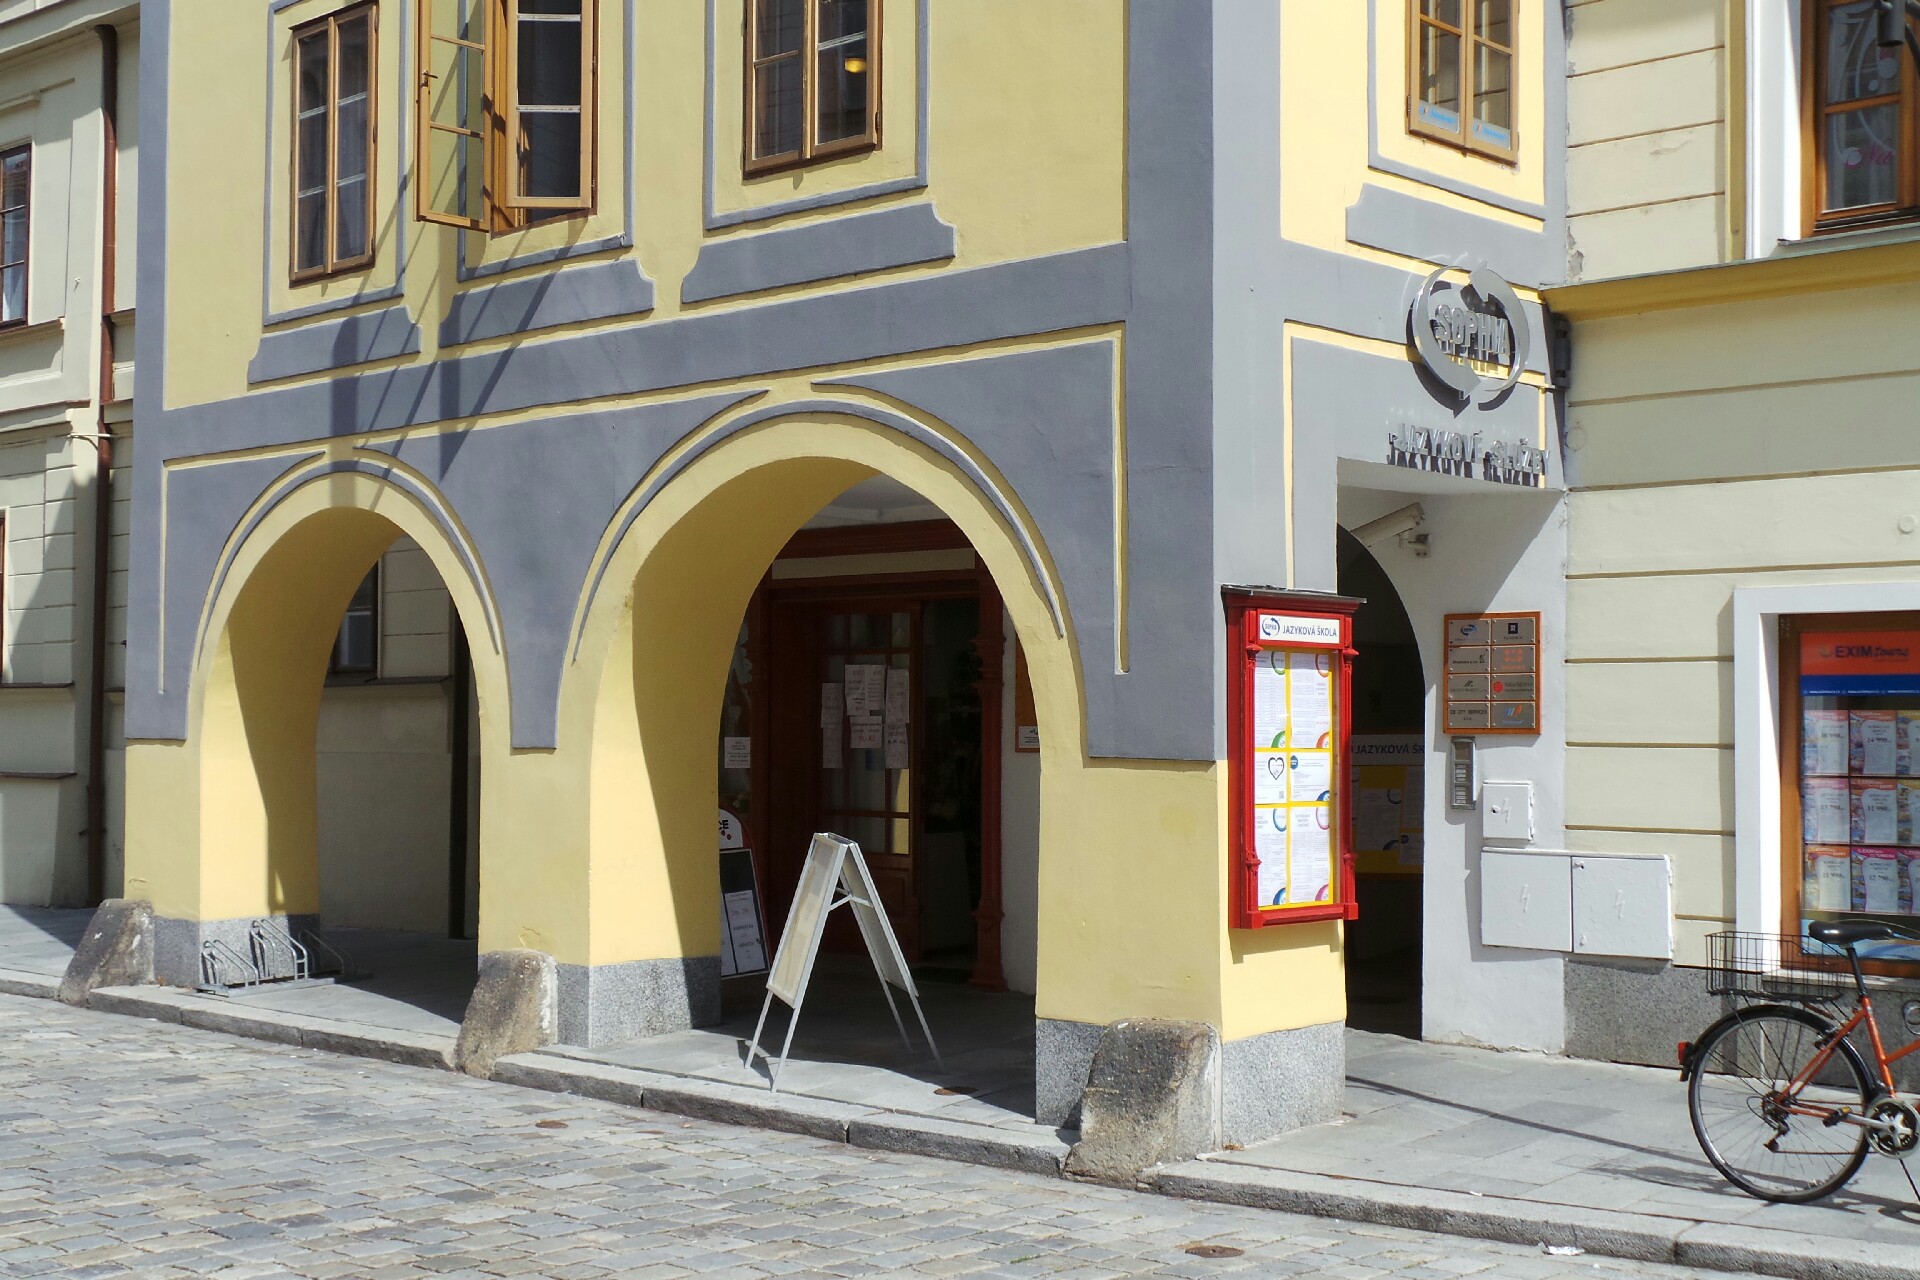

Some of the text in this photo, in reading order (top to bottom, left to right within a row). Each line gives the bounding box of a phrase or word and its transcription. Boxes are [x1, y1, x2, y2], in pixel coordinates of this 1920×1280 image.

[1434, 304, 1511, 355] SOPHIA
[1393, 423, 1483, 463] JAZYKOVÉ
[1282, 625, 1338, 637] JAZYKOVÁ ŠKOLA
[1836, 646, 1873, 658] EXIM
[1354, 743, 1410, 755] JAZYKOVÁ
